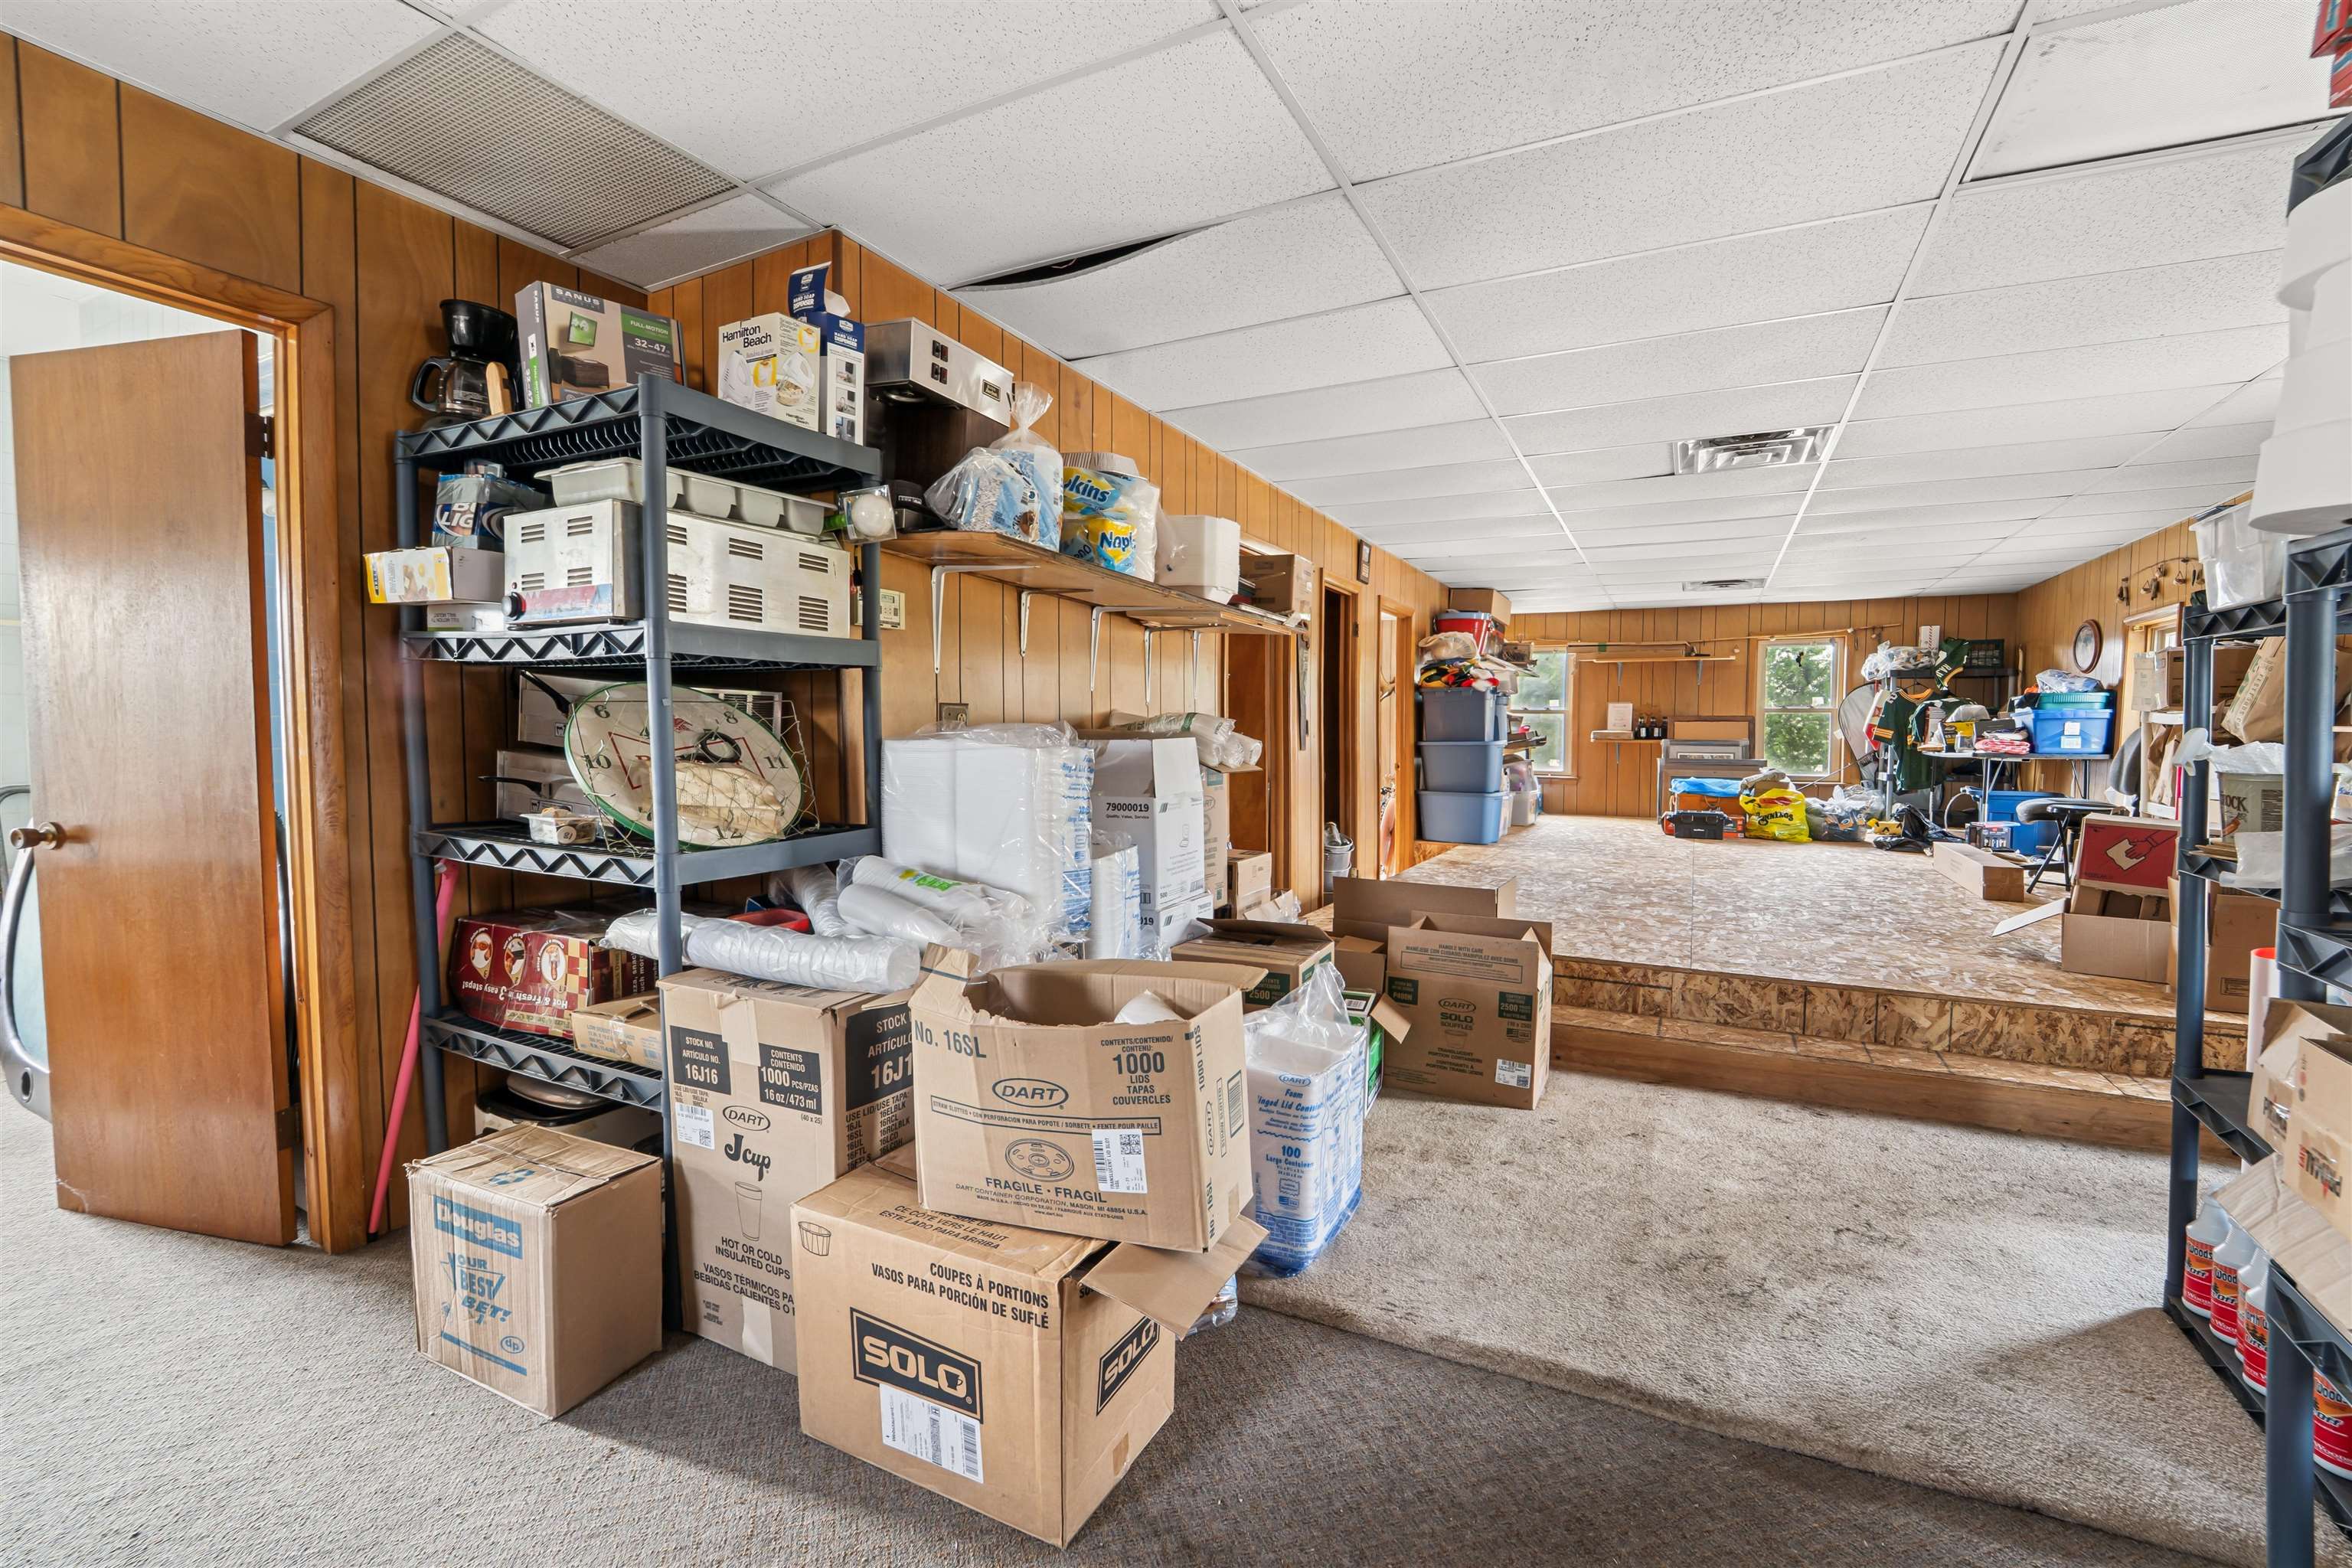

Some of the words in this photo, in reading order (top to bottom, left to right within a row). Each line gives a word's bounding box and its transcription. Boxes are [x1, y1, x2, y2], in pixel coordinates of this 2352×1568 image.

[555, 287, 600, 305] SANUS
[630, 320, 669, 336] FULL-MOTION
[722, 325, 761, 343] Hamilton
[743, 333, 773, 348] Beach
[766, 755, 789, 769] 11
[1106, 802, 1149, 812] 79000019
[462, 981, 483, 991] steps!
[485, 985, 498, 995] easy
[499, 986, 507, 1001] 3
[1249, 990, 1270, 1000] 2500
[517, 993, 542, 1005] Fresh
[554, 999, 568, 1010] Hot
[1442, 1001, 1472, 1010] DART
[1501, 1003, 1518, 1011] 2500
[877, 1014, 907, 1034] STOCK
[1440, 1012, 1473, 1024] SOLO
[685, 1037, 704, 1048] STOCK
[704, 1040, 714, 1050] NO.
[915, 1020, 938, 1047] No.
[942, 1029, 987, 1059] 16SL
[1100, 1035, 1174, 1047] CONTENTS/CONTENIDO/
[1122, 1044, 1154, 1053] CONTENU:
[1194, 1024, 1203, 1057] LIDS
[682, 1049, 708, 1063] ARTÍCULO
[710, 1054, 721, 1065] NO.
[771, 1049, 803, 1063] CONTENTS
[1112, 1052, 1165, 1074] 1000
[685, 1063, 718, 1085] 16J16
[770, 1059, 805, 1073] CONTENIDO
[871, 1053, 913, 1089] 16J1
[761, 1067, 790, 1088] 1000
[792, 1080, 819, 1093] PCS/PZAS
[1129, 1074, 1150, 1084] LIDS
[1196, 1059, 1206, 1092] 1000
[1282, 1076, 1306, 1085] DART
[1001, 1085, 1059, 1101] DART
[1126, 1085, 1155, 1095] TAPAS
[1285, 1089, 1303, 1099] Foam
[764, 1088, 775, 1100] 16
[805, 1098, 816, 1111] ml
[1112, 1095, 1171, 1106] COUVERCLES
[1281, 1100, 1293, 1110] Lid
[727, 1110, 764, 1128] DART
[800, 1113, 810, 1123] (40
[846, 1110, 861, 1122] USE
[863, 1099, 890, 1116] LID/USE
[847, 1120, 862, 1132] 16JL
[880, 1102, 906, 1118] 16ELBLK
[847, 1129, 863, 1142] 16SL
[880, 1114, 898, 1128] 16RCL
[847, 1138, 864, 1151] 16UL
[880, 1117, 910, 1136] 16RCLBLK
[1266, 1154, 1282, 1165] Large
[1282, 1145, 1301, 1158] 100
[975, 1187, 1013, 1200] CONTAINER
[1014, 1193, 1068, 1207] CORPORATION,
[1070, 1202, 1096, 1211] MASON,
[985, 1178, 1044, 1195] FRAGILE
[1055, 1187, 1107, 1203] FRAGIL
[435, 1201, 521, 1250] Douglas
[894, 1205, 913, 1214] CE
[938, 1218, 963, 1230] VERS
[978, 1230, 1009, 1242] HAUT
[952, 1215, 977, 1225] SIDE
[879, 1210, 905, 1222] ESTE
[904, 1218, 934, 1230] LADO
[933, 1227, 962, 1238] PARA
[961, 1236, 1001, 1250] ARRIBA
[721, 1236, 739, 1250] HOT
[742, 1244, 754, 1256] OR
[757, 1249, 782, 1265] COLD
[447, 1252, 488, 1270] YOUR
[715, 1246, 763, 1269] INSULATED
[766, 1263, 791, 1279] CUPS
[459, 1269, 495, 1297] BEST
[704, 1263, 732, 1281] VASOS
[734, 1273, 780, 1299] TÉRMICOS
[782, 1292, 795, 1305] PA
[929, 1263, 972, 1289] COUPES
[976, 1272, 985, 1292] À
[988, 1280, 1049, 1309] PORTIONS
[2215, 1269, 2238, 1285] Wood
[694, 1270, 731, 1291] BEBIDAS
[733, 1285, 781, 1310] CALIENTES
[782, 1304, 790, 1314] O
[871, 1263, 903, 1285] VASOS
[906, 1275, 936, 1295] PARA
[939, 1283, 988, 1313] PORCIÓN
[991, 1298, 1008, 1317] DE
[1011, 1305, 1049, 1329] SUFLÉ
[460, 1295, 512, 1323] BET!
[1104, 1320, 1155, 1390] SOLO
[863, 1334, 968, 1400] SOLO
